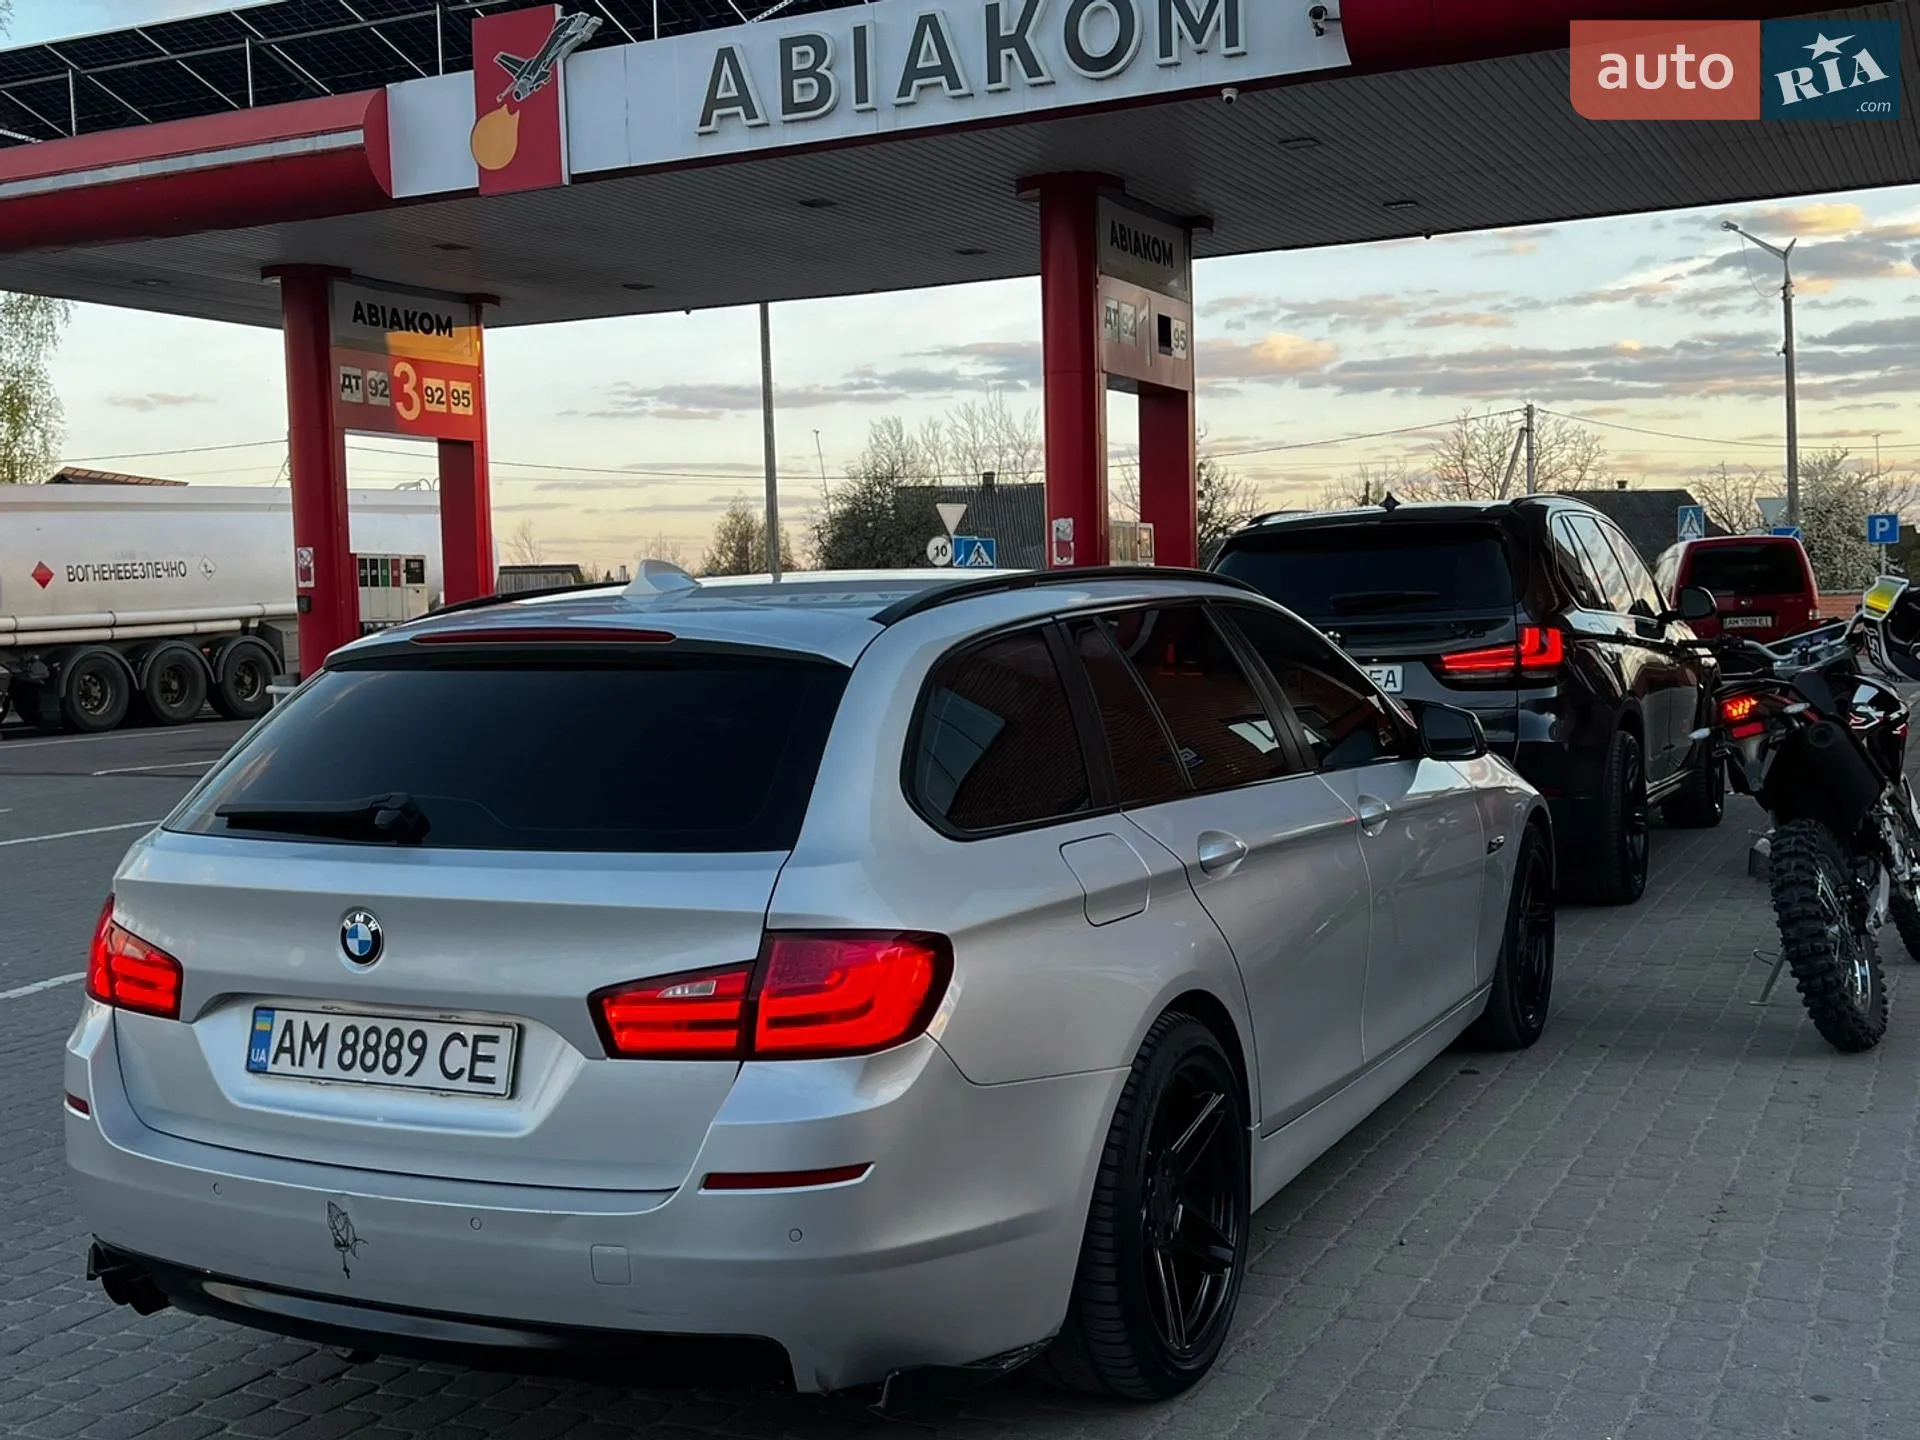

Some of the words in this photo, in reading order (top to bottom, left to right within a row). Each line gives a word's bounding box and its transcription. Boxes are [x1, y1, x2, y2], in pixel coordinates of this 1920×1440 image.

[698, 0, 1248, 135] АВІАКОМ
[1110, 220, 1174, 269] АВІАКОМ
[352, 301, 453, 338] АВІАКОМ
[1173, 328, 1187, 351] 95
[368, 378, 389, 398] 92
[393, 361, 421, 421] 3
[424, 386, 445, 405] 92
[451, 388, 471, 408] 95
[1875, 518, 1889, 540] P
[66, 560, 188, 583] ВОГНЕНЕБЕЗПЕЧНО
[251, 1047, 267, 1063] UA
[272, 1019, 330, 1069] AM
[337, 1024, 428, 1077] 8889
[438, 1032, 500, 1085] CE
